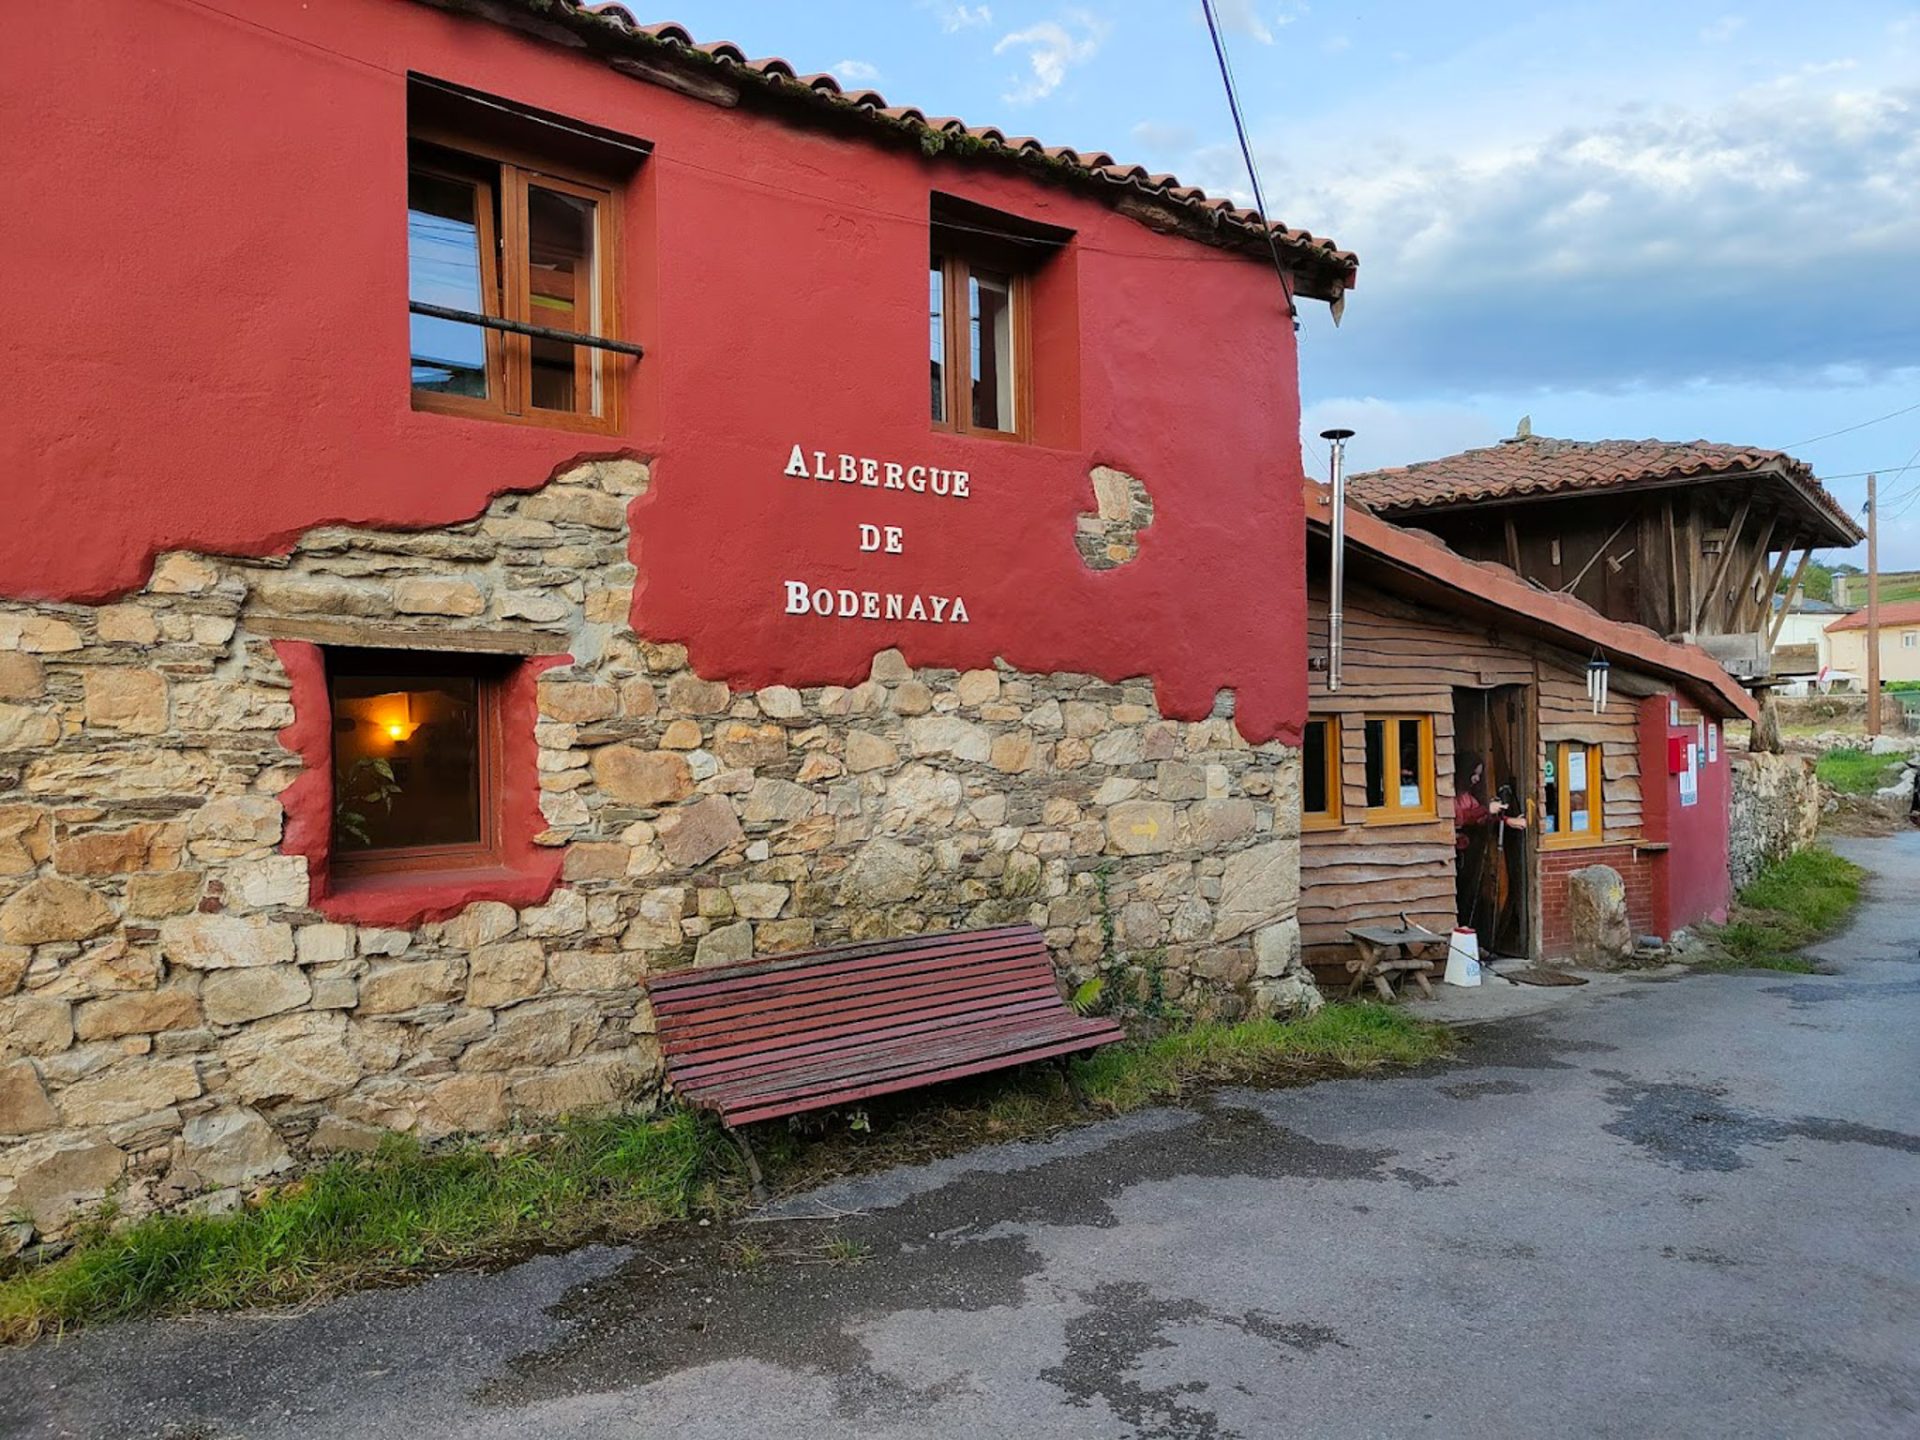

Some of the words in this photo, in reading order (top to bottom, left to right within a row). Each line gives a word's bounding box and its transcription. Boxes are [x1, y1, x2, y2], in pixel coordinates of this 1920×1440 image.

[784, 444, 970, 497] ALBERGUE
[859, 523, 903, 553] DE
[784, 580, 970, 622] BODENAYA
